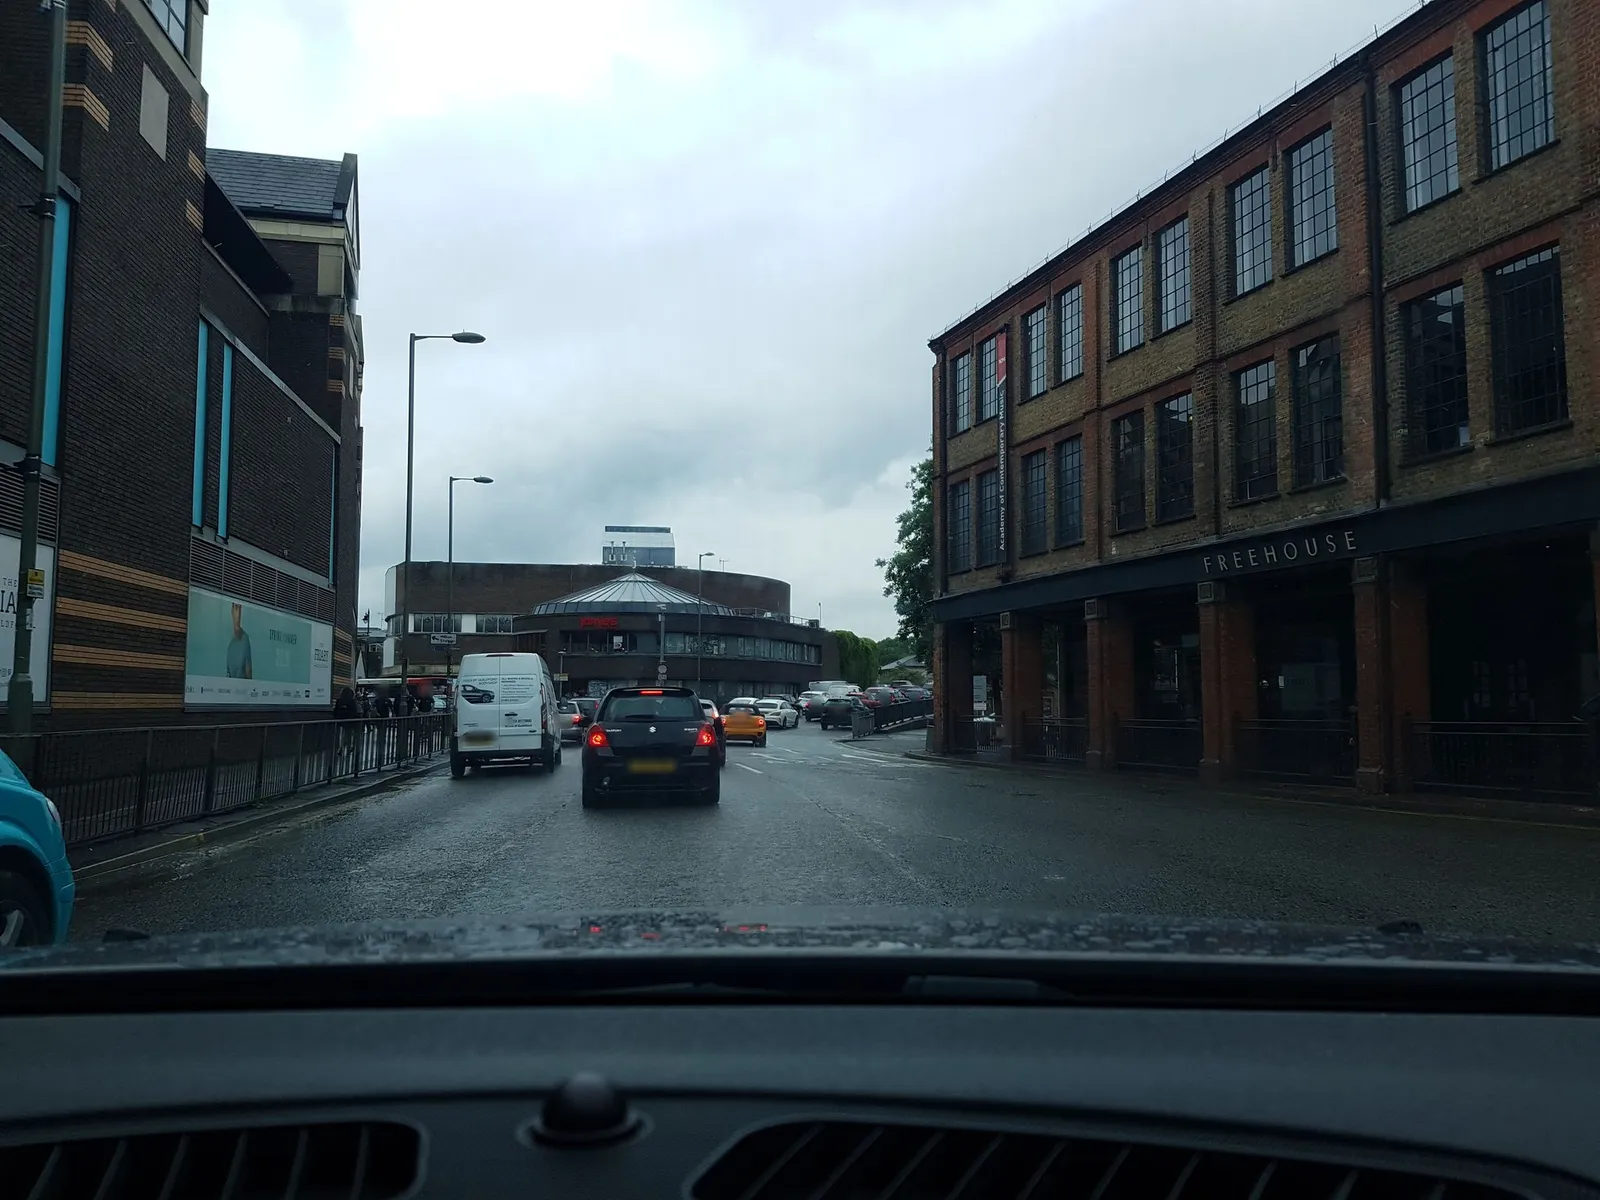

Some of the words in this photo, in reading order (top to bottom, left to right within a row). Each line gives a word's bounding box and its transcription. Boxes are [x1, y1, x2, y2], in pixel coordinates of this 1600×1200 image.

[999, 494, 1005, 504] of
[1203, 531, 1357, 573] FREEHOUSE
[3, 577, 18, 588] THE
